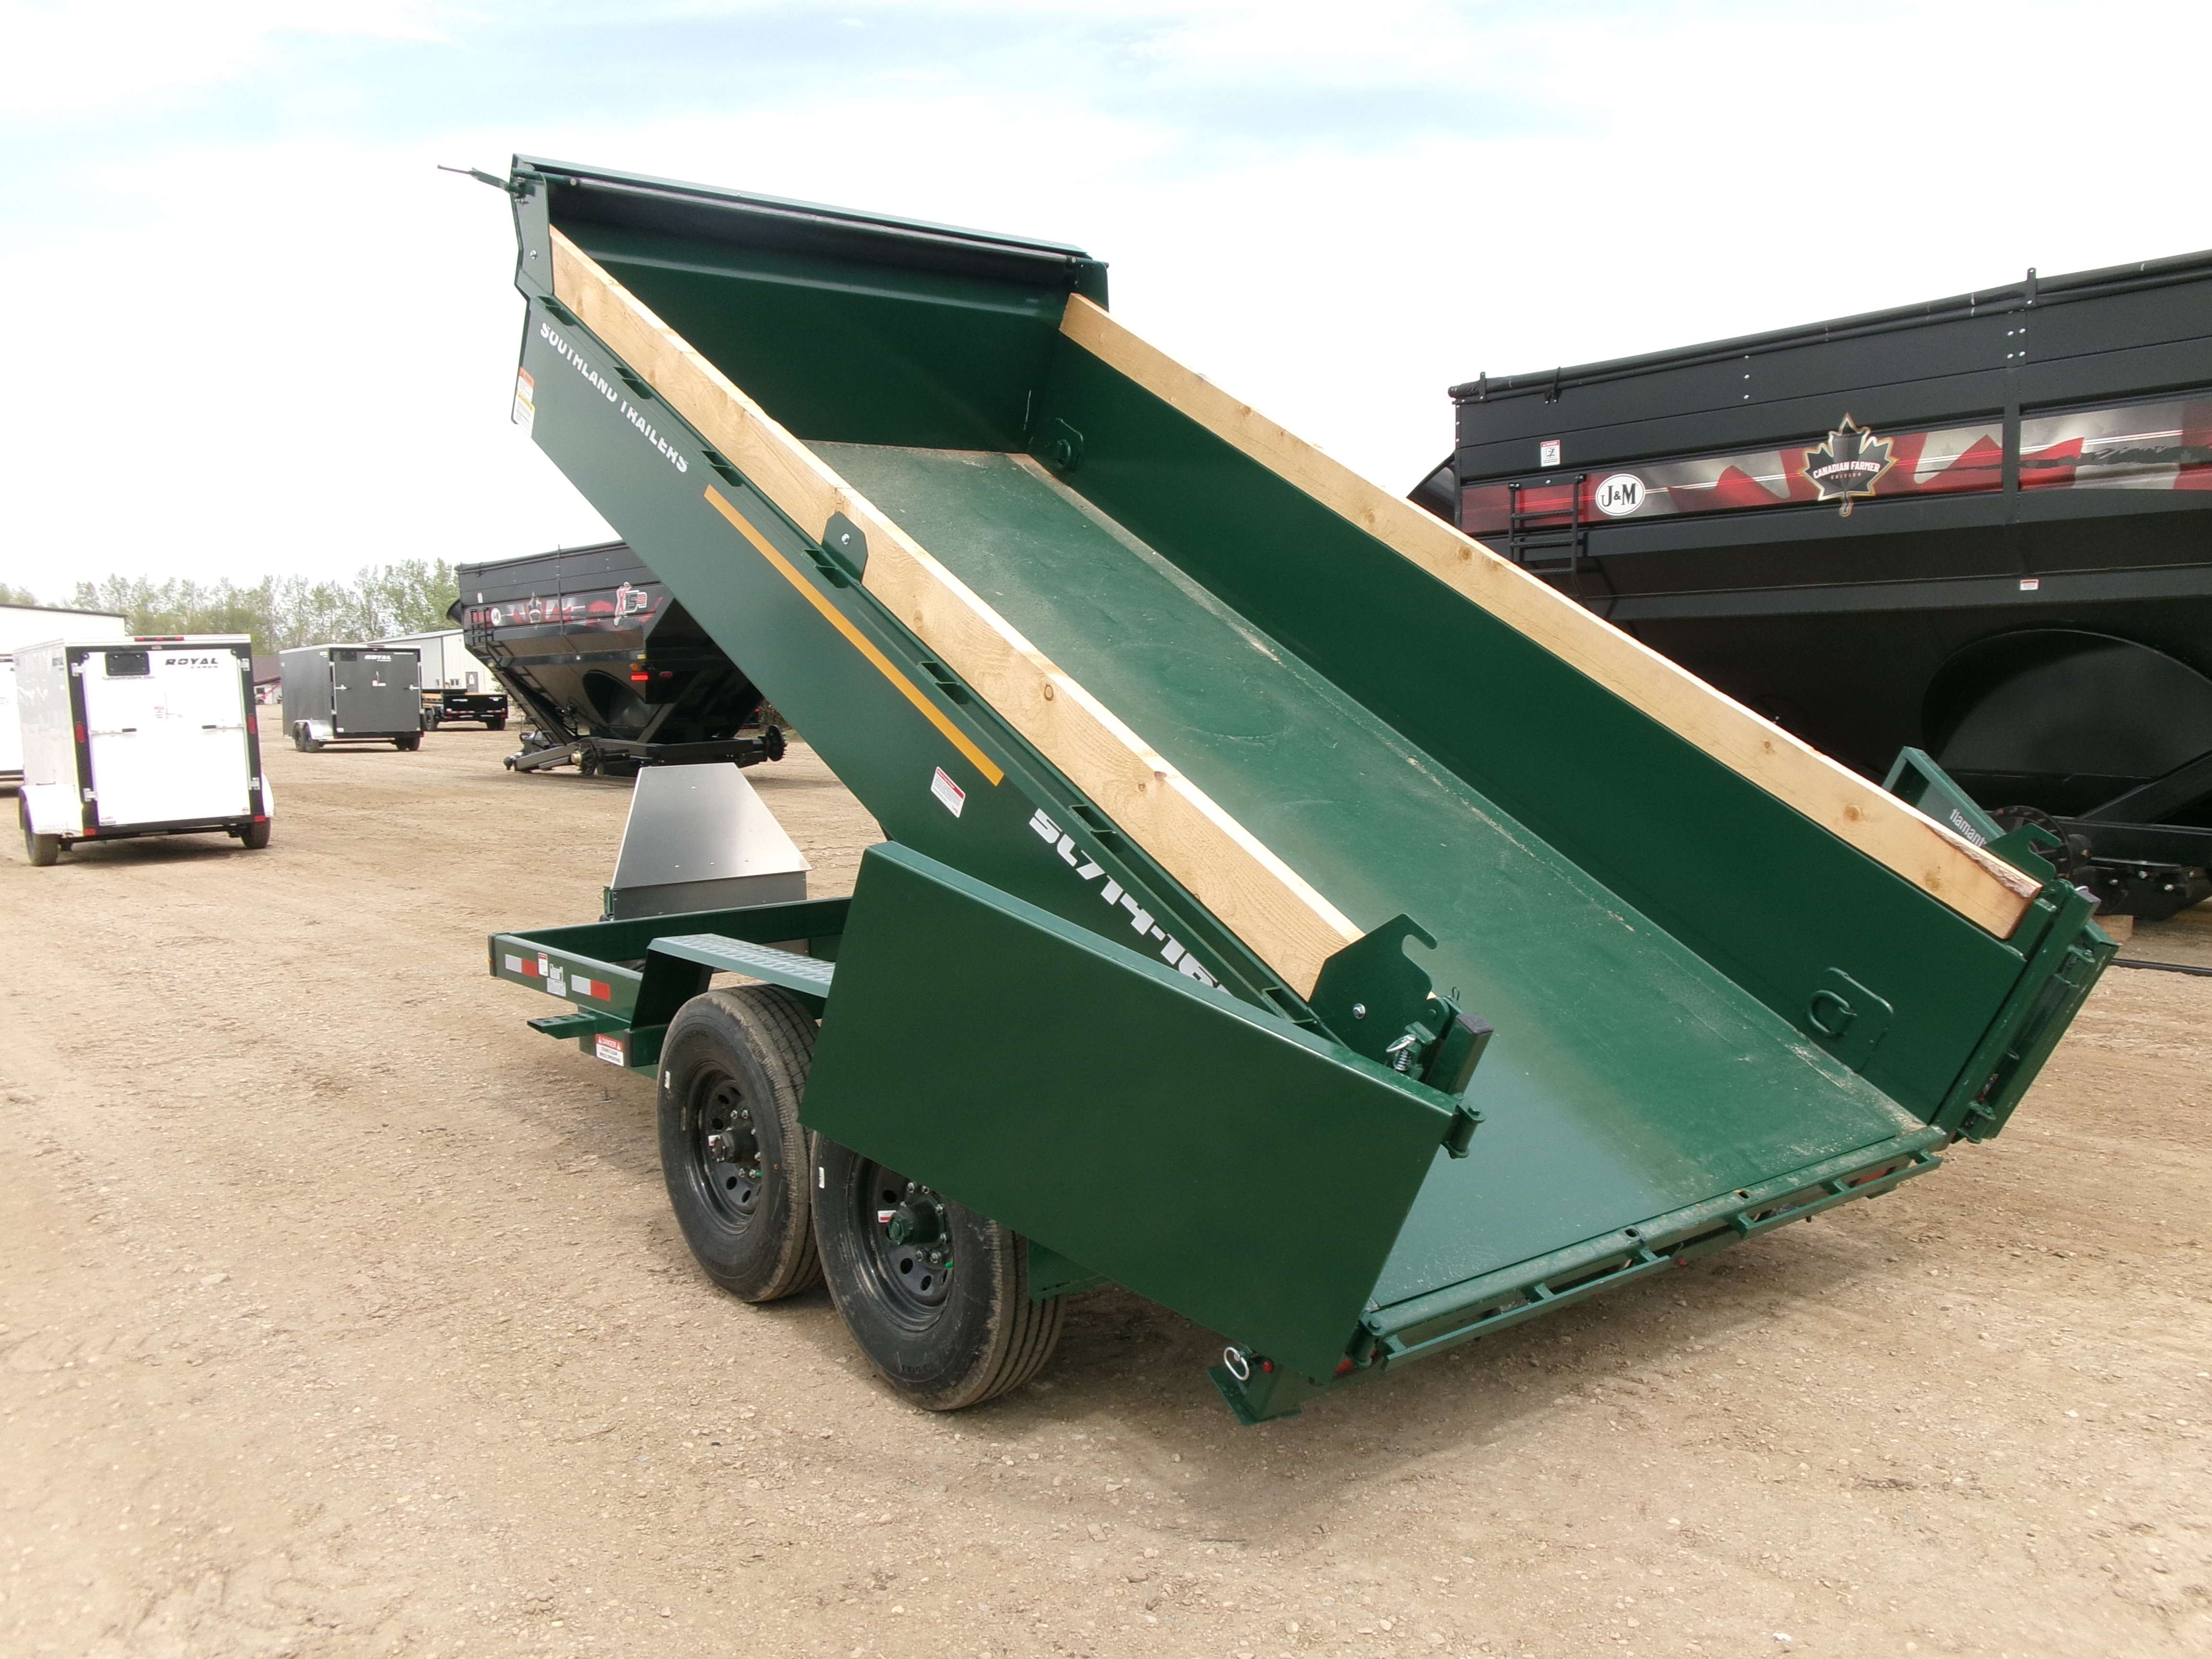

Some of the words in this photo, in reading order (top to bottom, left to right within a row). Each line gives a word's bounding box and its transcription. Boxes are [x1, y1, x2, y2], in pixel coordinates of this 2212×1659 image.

[540, 322, 618, 402] SOUTHLAND
[620, 398, 689, 473] TRAILERS
[1813, 461, 1850, 479] CANADIAN
[1850, 460, 1881, 473] FARMER
[1600, 483, 1637, 507] J&M
[165, 657, 219, 666] ROYAL
